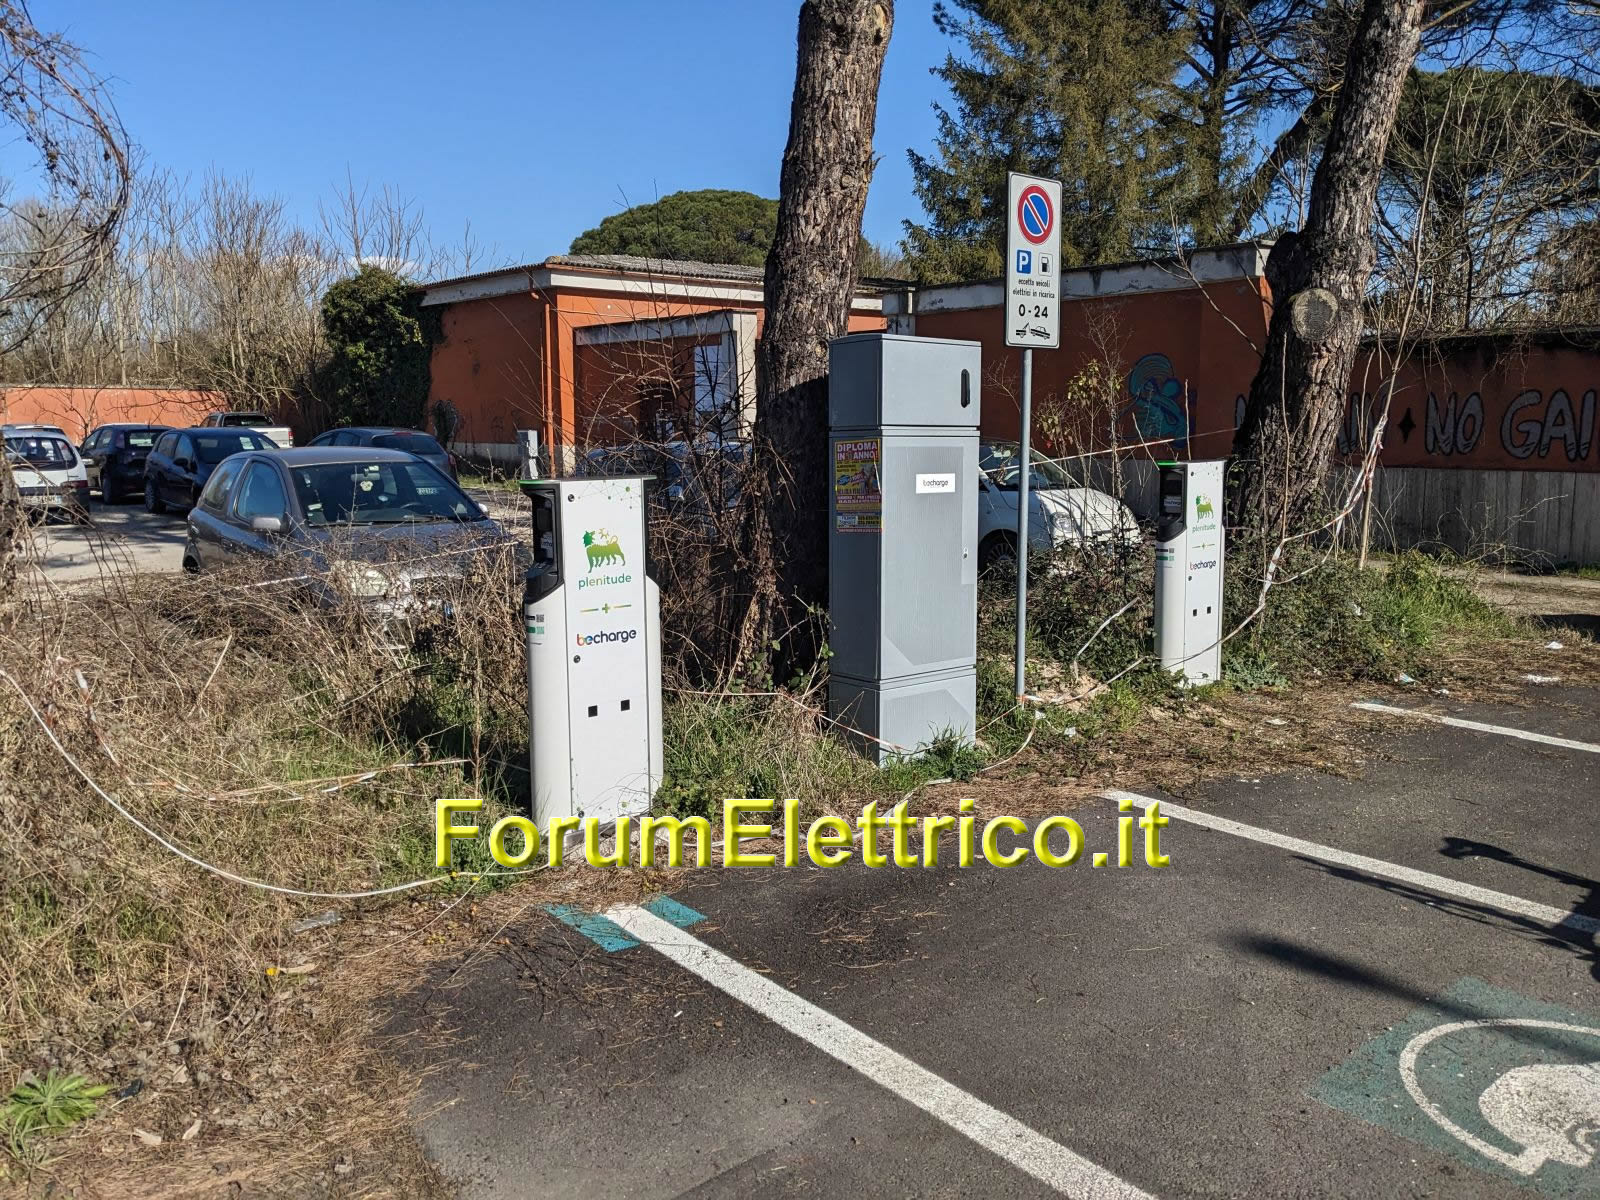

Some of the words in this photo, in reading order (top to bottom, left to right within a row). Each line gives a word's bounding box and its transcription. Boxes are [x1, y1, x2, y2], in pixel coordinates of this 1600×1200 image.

[1019, 252, 1029, 272] P
[1013, 288, 1031, 296] elettrici
[1039, 290, 1055, 298] ricarica
[1019, 304, 1025, 316] 0
[1034, 305, 1048, 318] 24
[1424, 391, 1485, 456] NO
[837, 441, 877, 452] DIPLOMA
[838, 452, 845, 460] IN
[922, 479, 949, 487] becharge
[1192, 524, 1216, 534] plenitude
[1190, 560, 1216, 571] becharge
[578, 573, 632, 590] plenitude
[576, 629, 637, 647] becharge
